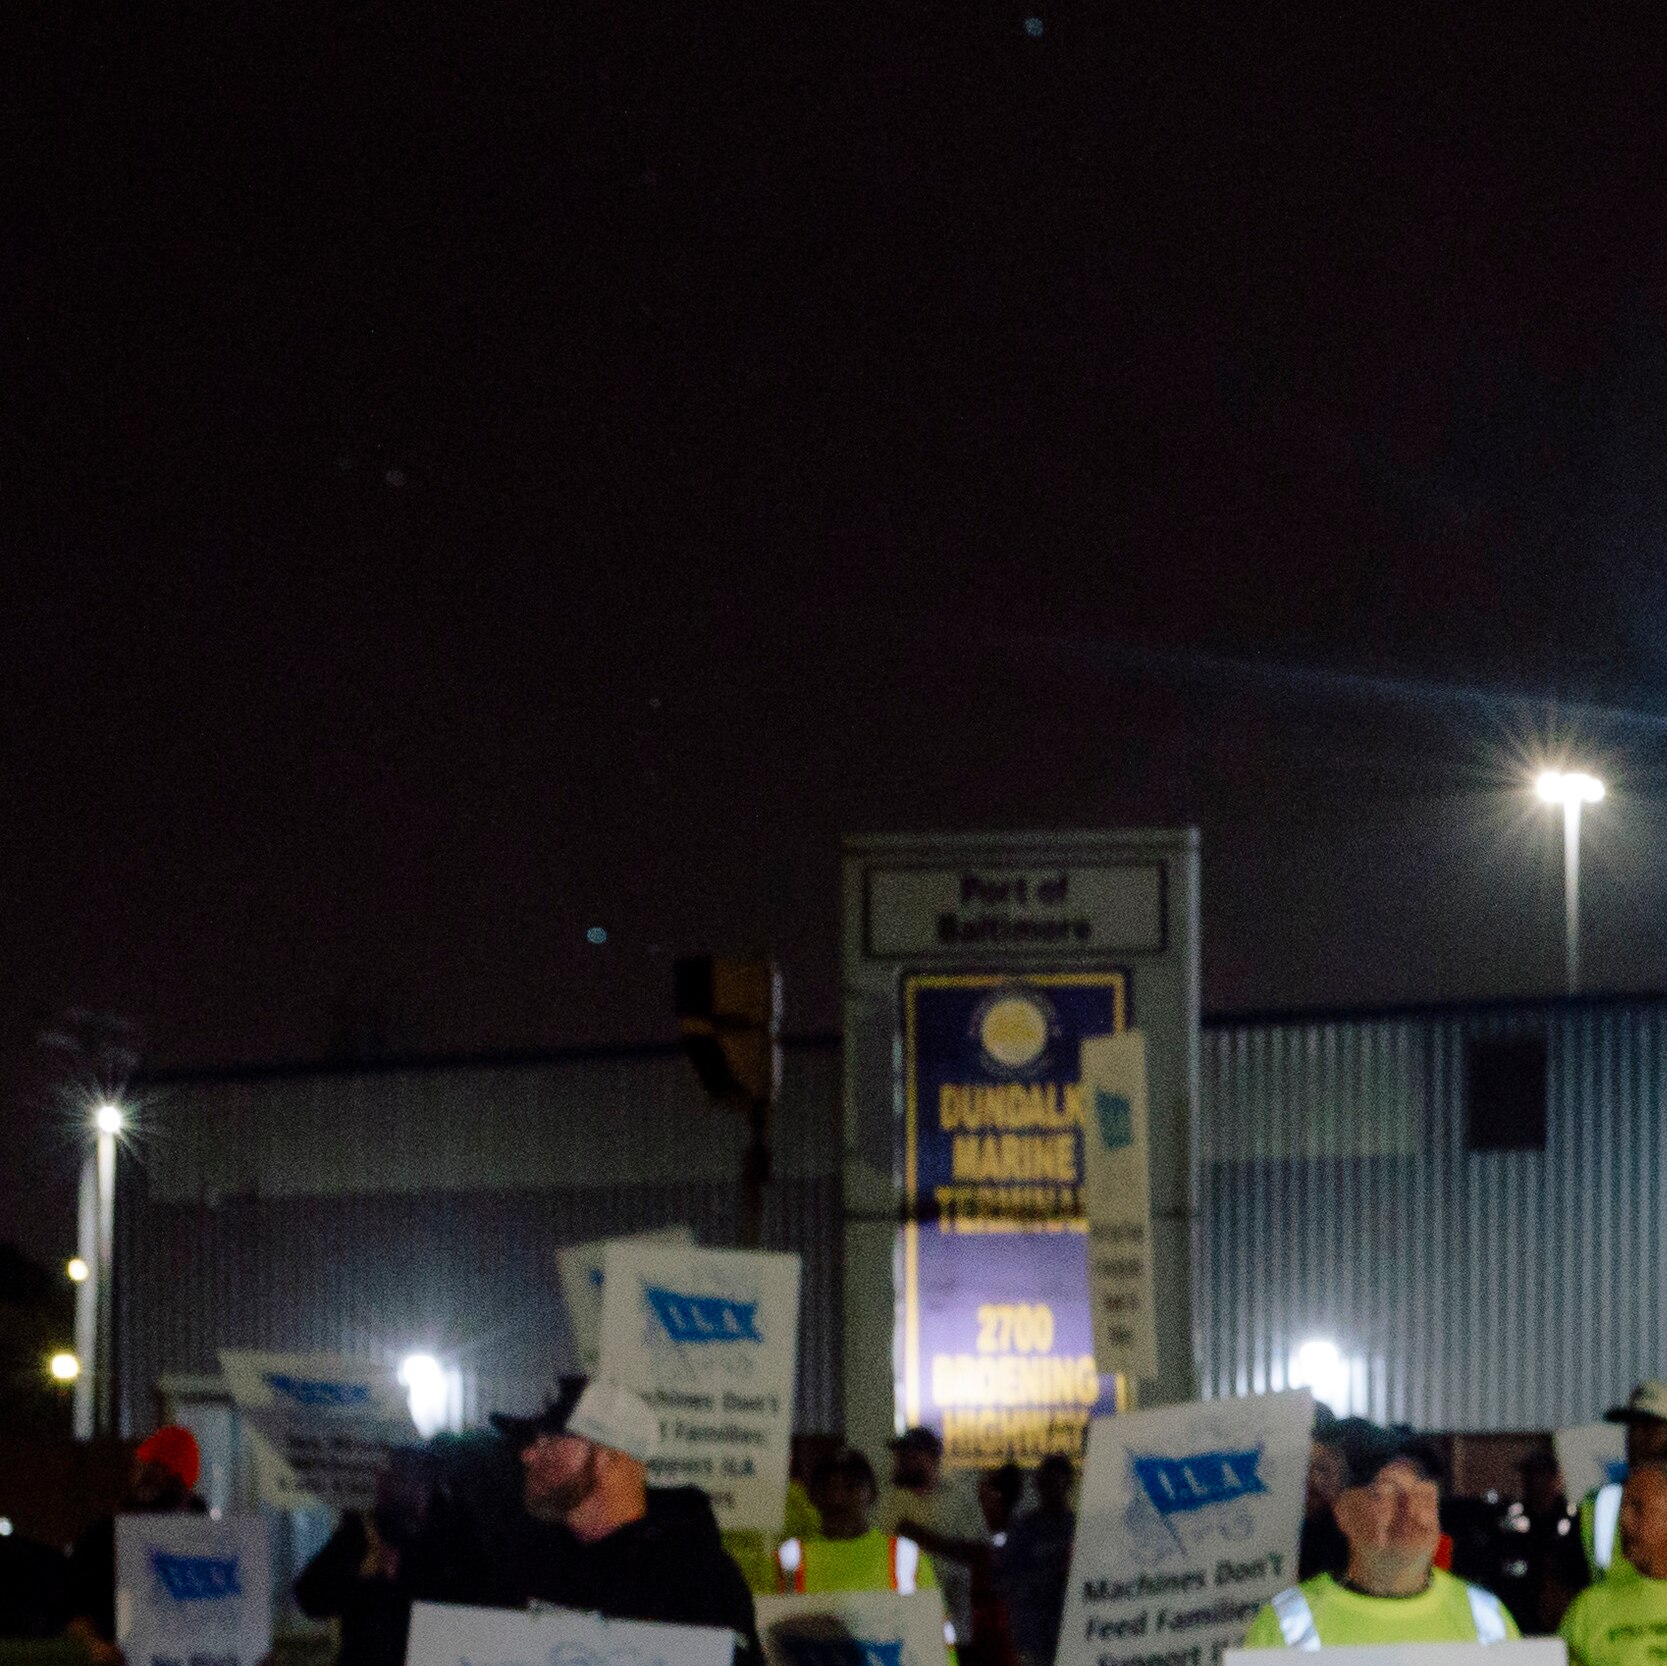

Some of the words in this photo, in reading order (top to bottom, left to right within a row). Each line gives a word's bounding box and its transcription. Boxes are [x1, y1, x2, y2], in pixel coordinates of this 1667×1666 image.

[977, 1304, 1055, 1353] 2700
[1083, 1569, 1206, 1602] Machines
[1214, 1551, 1284, 1587] Don't
[1087, 1609, 1149, 1642] Feed
